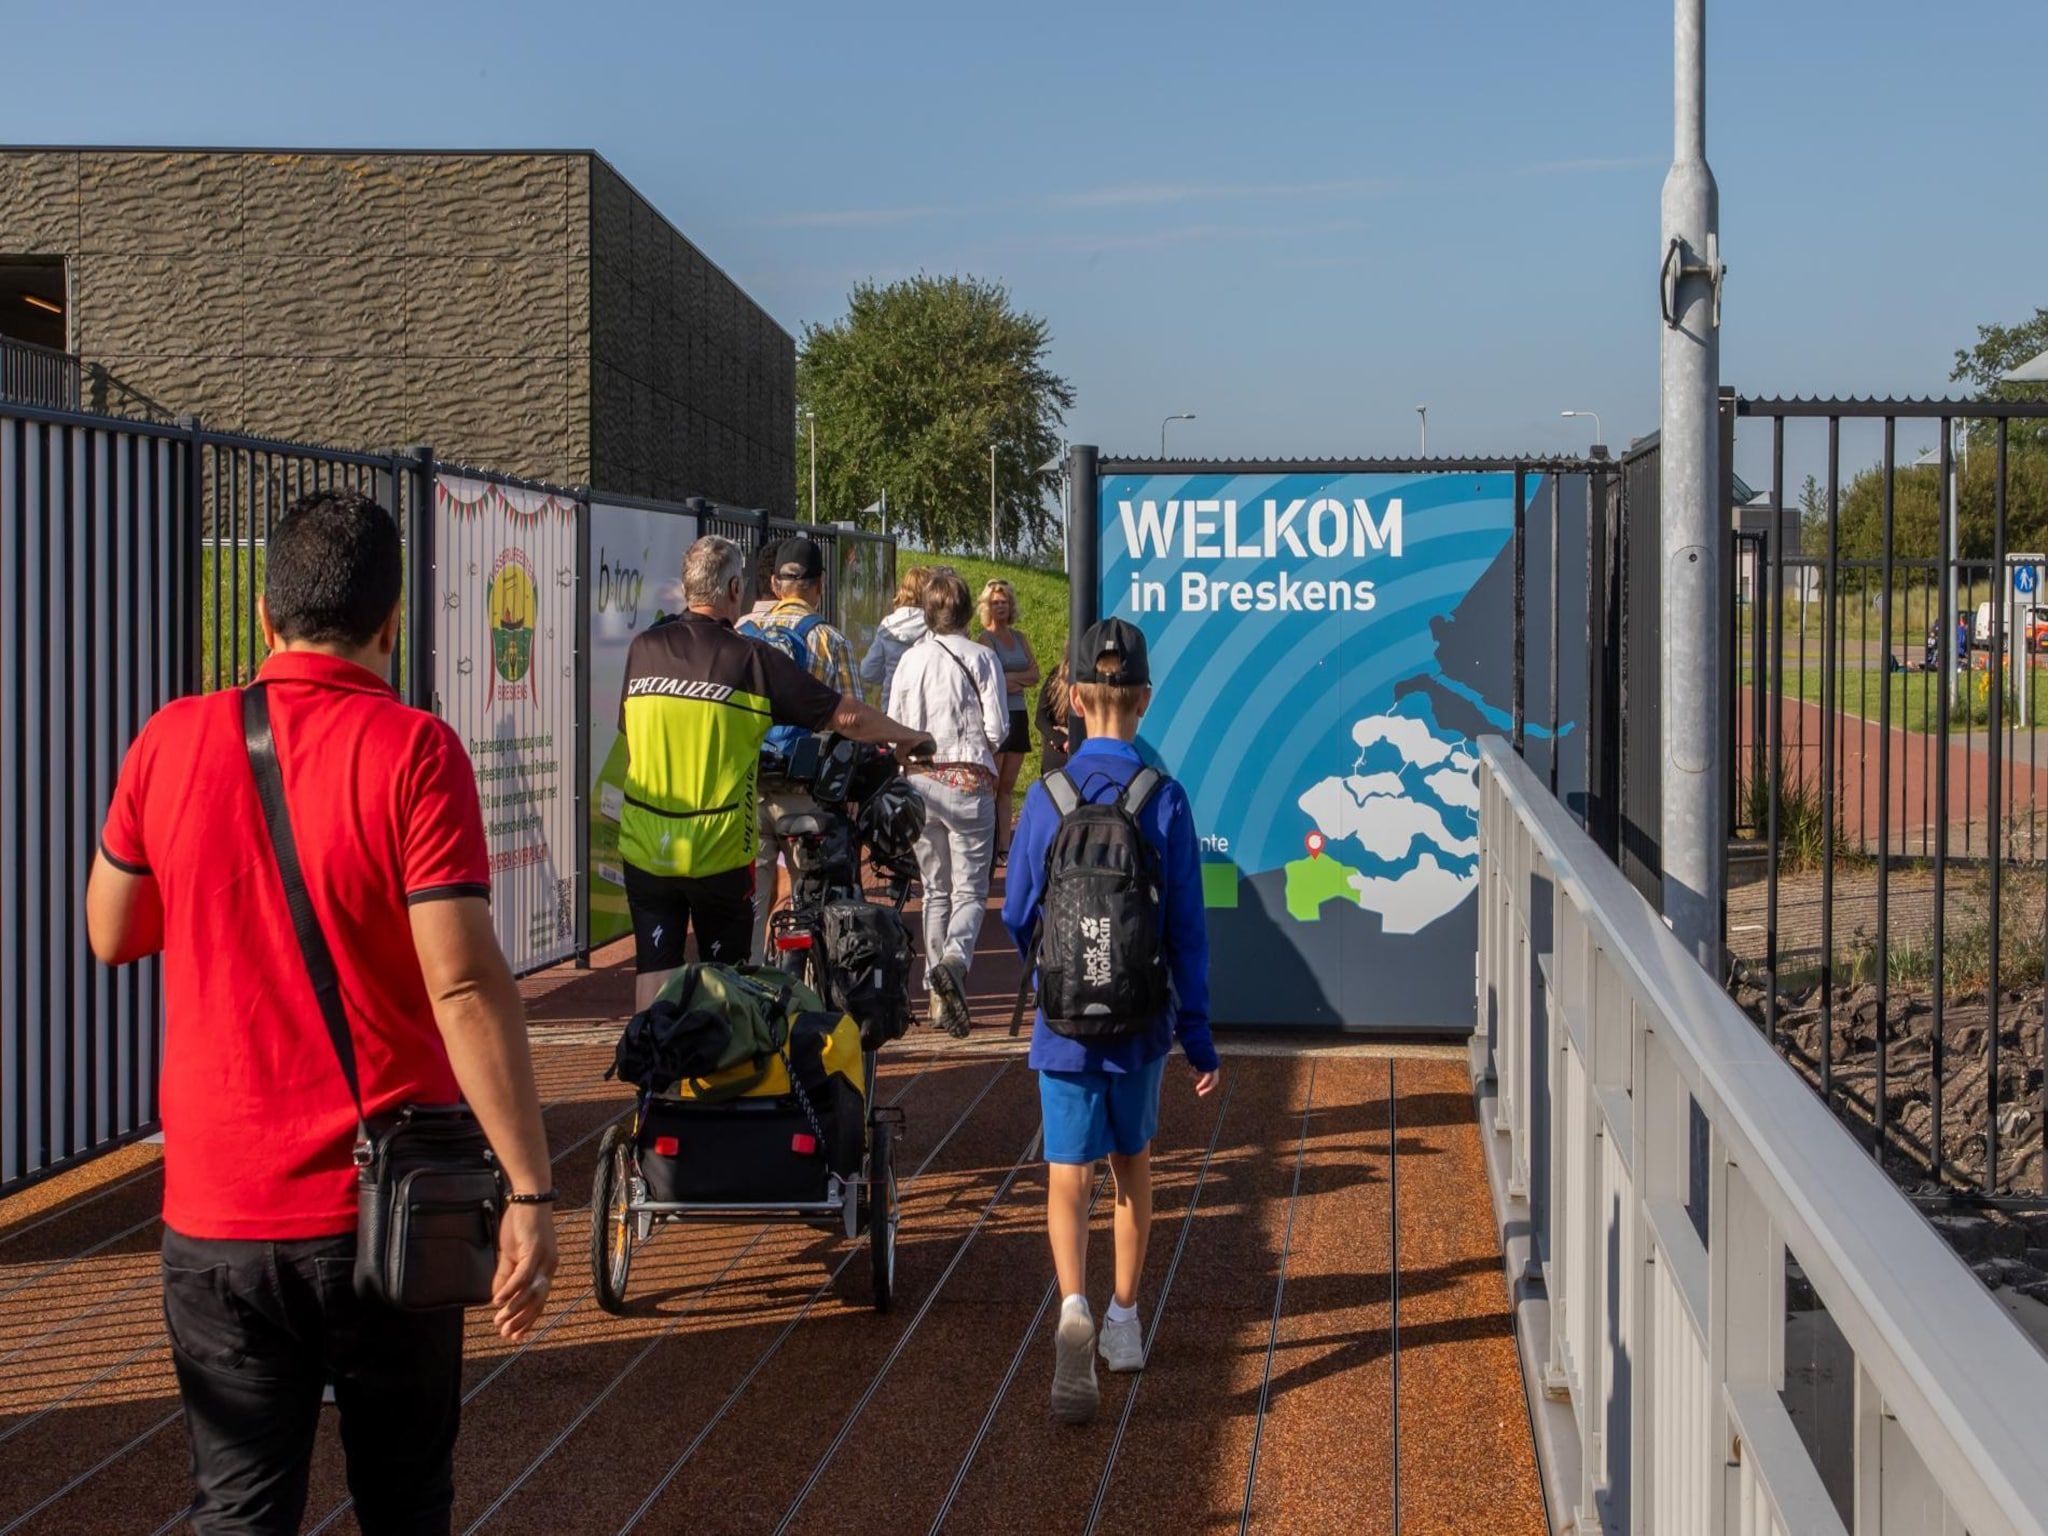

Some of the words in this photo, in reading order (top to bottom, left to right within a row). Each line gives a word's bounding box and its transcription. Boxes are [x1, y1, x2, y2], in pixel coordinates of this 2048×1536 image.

[1118, 498, 1402, 559] WELKOM
[1131, 572, 1166, 612] in
[1181, 571, 1377, 612] Breskens
[628, 676, 733, 701] SPECIALIZED
[1083, 946, 1097, 986] Jack
[1097, 917, 1111, 986] Wolfskin
